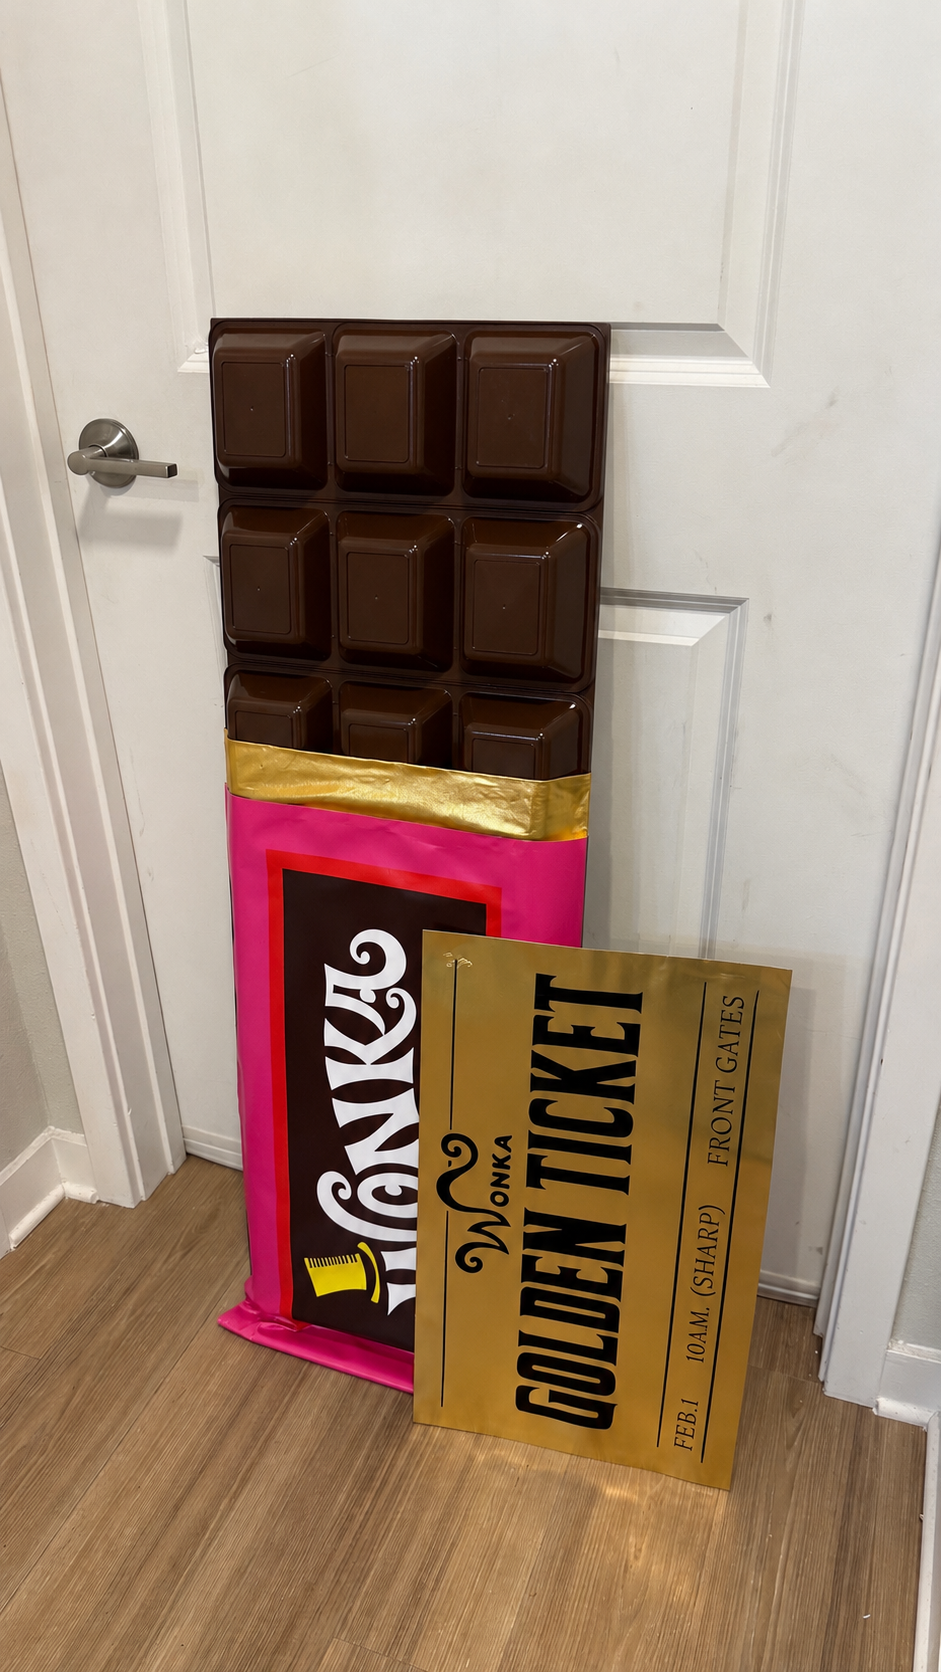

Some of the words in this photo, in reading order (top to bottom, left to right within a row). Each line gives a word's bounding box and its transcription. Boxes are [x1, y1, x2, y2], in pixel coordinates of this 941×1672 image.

[716, 996, 745, 1074] GATES
[526, 973, 643, 1195] TICKET
[707, 1080, 735, 1167] FRONT
[690, 1204, 726, 1298] (SHARP)
[515, 1208, 627, 1430] GOLDEN
[673, 1398, 699, 1451] FEB.1
